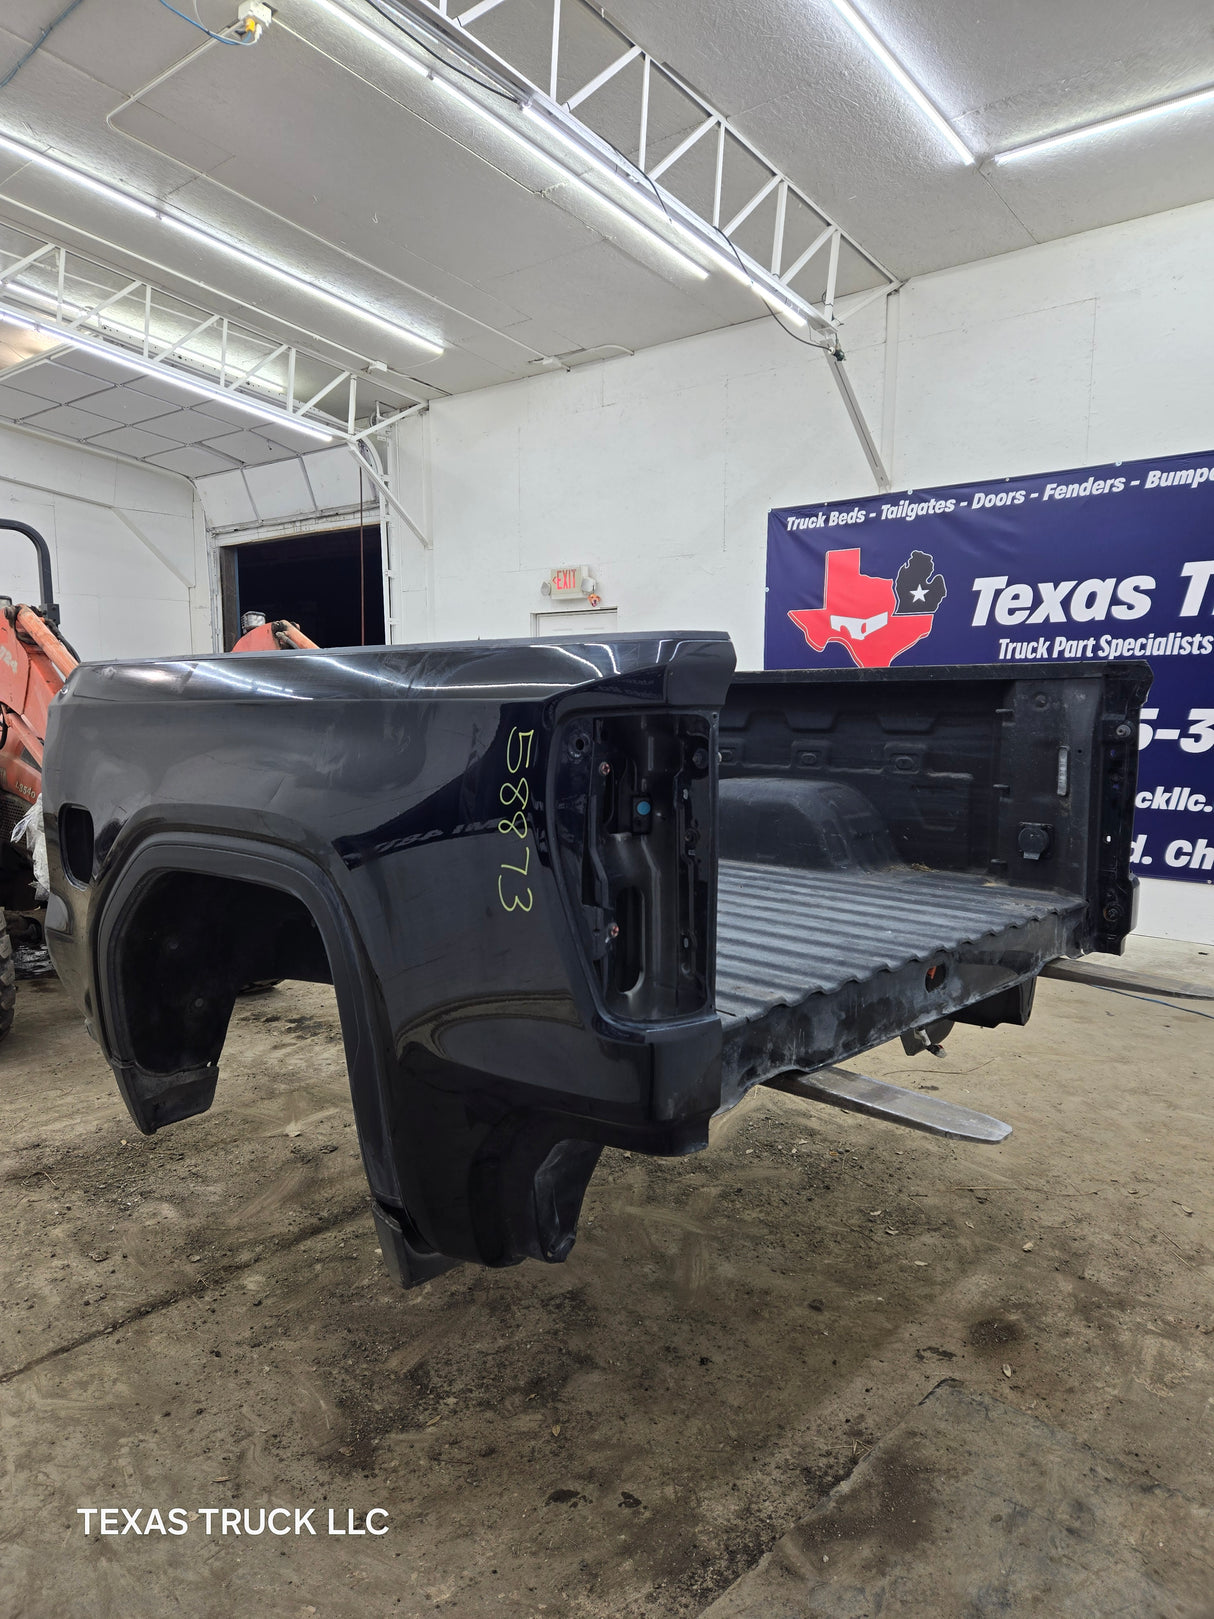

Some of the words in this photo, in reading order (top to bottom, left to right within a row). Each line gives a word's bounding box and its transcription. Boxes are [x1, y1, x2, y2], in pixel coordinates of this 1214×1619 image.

[785, 512, 826, 532] Truck
[828, 506, 867, 528] Beds
[880, 497, 957, 521] Tailgates
[971, 489, 1027, 511] Doors
[1041, 475, 1128, 502] Fenders
[556, 569, 577, 590] EXIT
[971, 573, 1157, 627] Texas
[1178, 559, 1214, 617] T
[998, 636, 1051, 660] Truck
[1052, 635, 1096, 659] Part
[1097, 632, 1213, 662] Specialists
[497, 725, 535, 913] 58873
